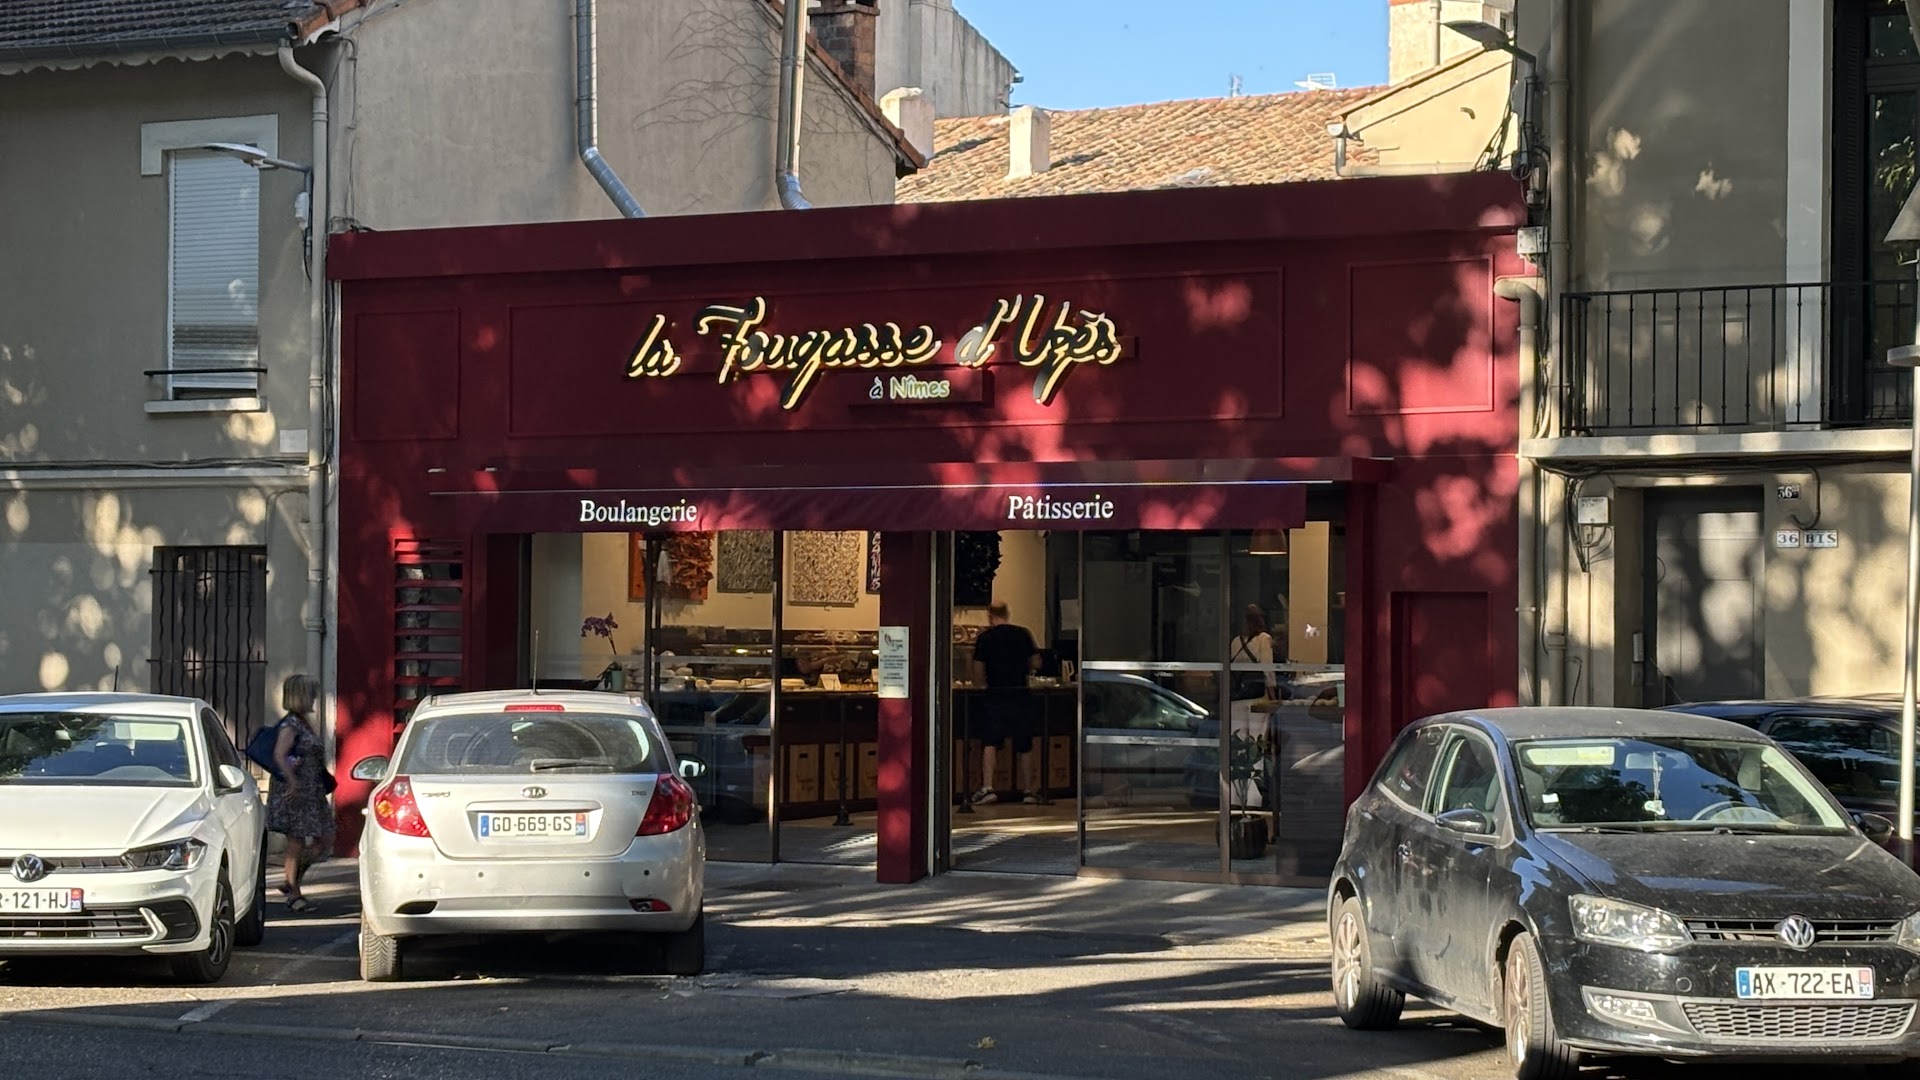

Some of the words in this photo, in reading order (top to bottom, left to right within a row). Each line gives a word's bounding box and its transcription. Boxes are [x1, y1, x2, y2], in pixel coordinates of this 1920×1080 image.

[627, 314, 681, 377] la
[693, 296, 942, 410] Fougasse
[869, 376, 884, 399] à
[890, 374, 950, 399] Nîmes
[579, 498, 698, 526] Boulangerie
[1007, 494, 1115, 520] Pâtisserie
[1777, 533, 1799, 544] 36
[1805, 533, 1837, 544] BIS
[491, 816, 573, 832] GD-669-GS
